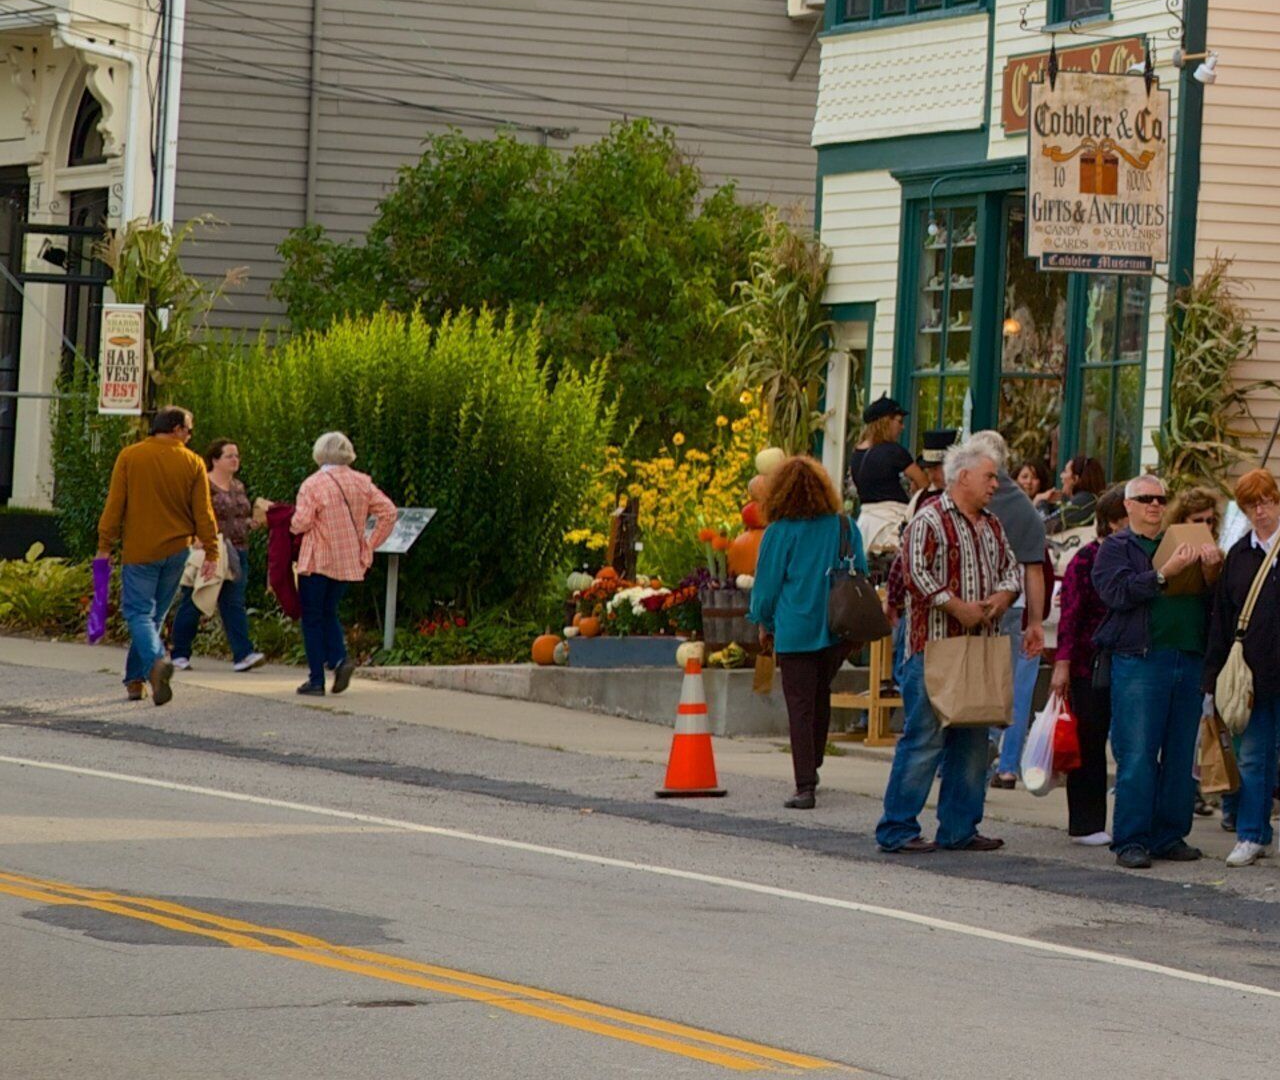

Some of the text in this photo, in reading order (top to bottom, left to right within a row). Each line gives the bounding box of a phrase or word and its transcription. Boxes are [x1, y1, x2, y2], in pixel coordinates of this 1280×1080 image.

[1034, 102, 1166, 144] Cobbler & Co.
[1053, 166, 1066, 188] 10
[1032, 192, 1165, 230] GIFTS & ANTIQUES
[1044, 224, 1082, 236] CANDY
[1103, 227, 1162, 240] SOUVENIRS
[1053, 237, 1089, 249] CARDS
[1107, 240, 1154, 252] JEWELRY
[1048, 254, 1147, 269] Cobbler Museum
[107, 349, 139, 365] HAR-
[106, 366, 139, 382] VEST
[104, 382, 138, 397] FEST
